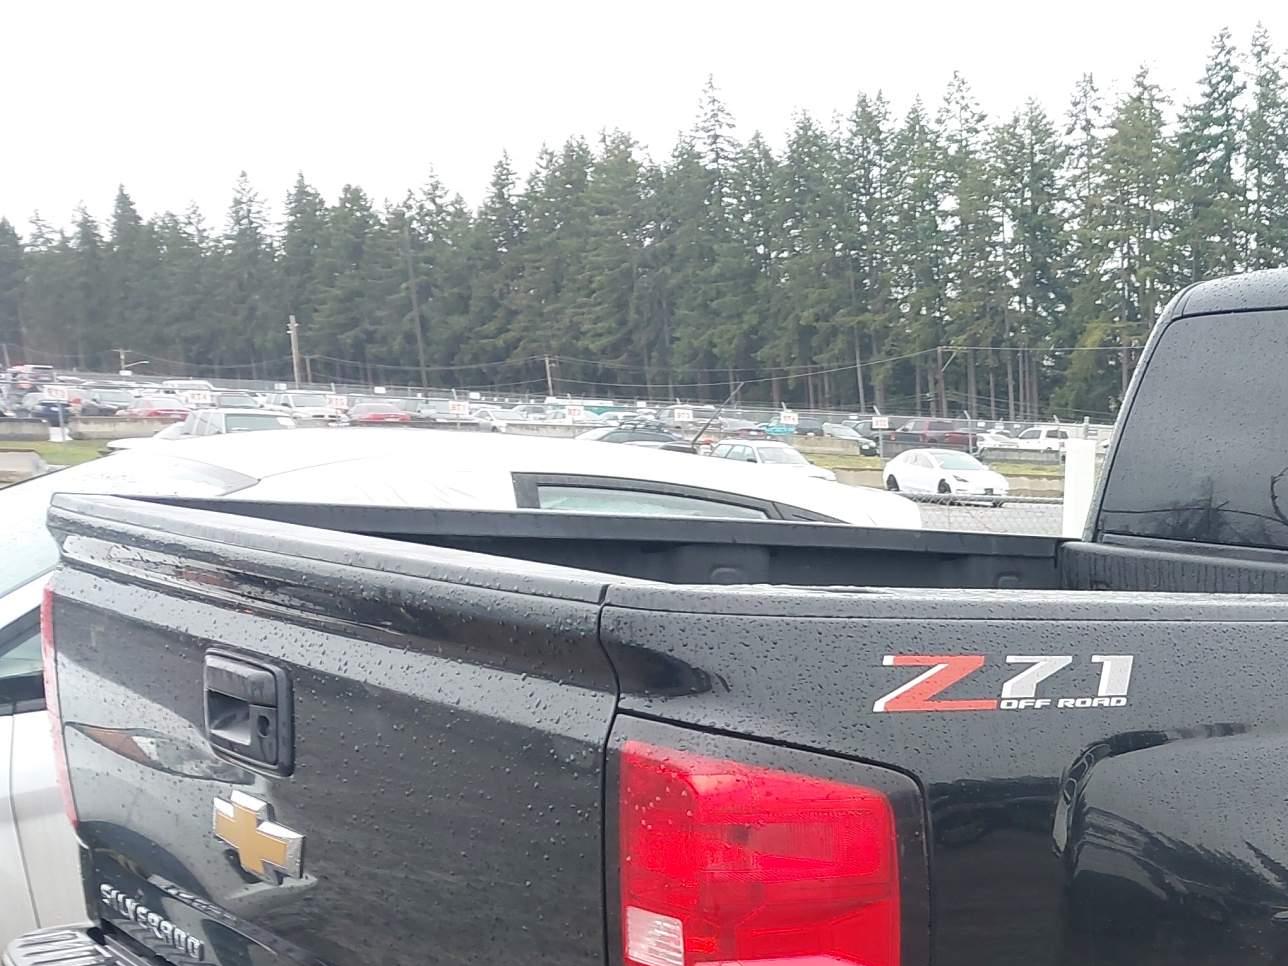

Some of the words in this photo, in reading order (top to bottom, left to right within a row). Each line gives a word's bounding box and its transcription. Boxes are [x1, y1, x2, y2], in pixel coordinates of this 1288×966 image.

[873, 655, 1134, 712] Z71
[1000, 698, 1051, 709] OFF
[1057, 697, 1127, 708] ROAD
